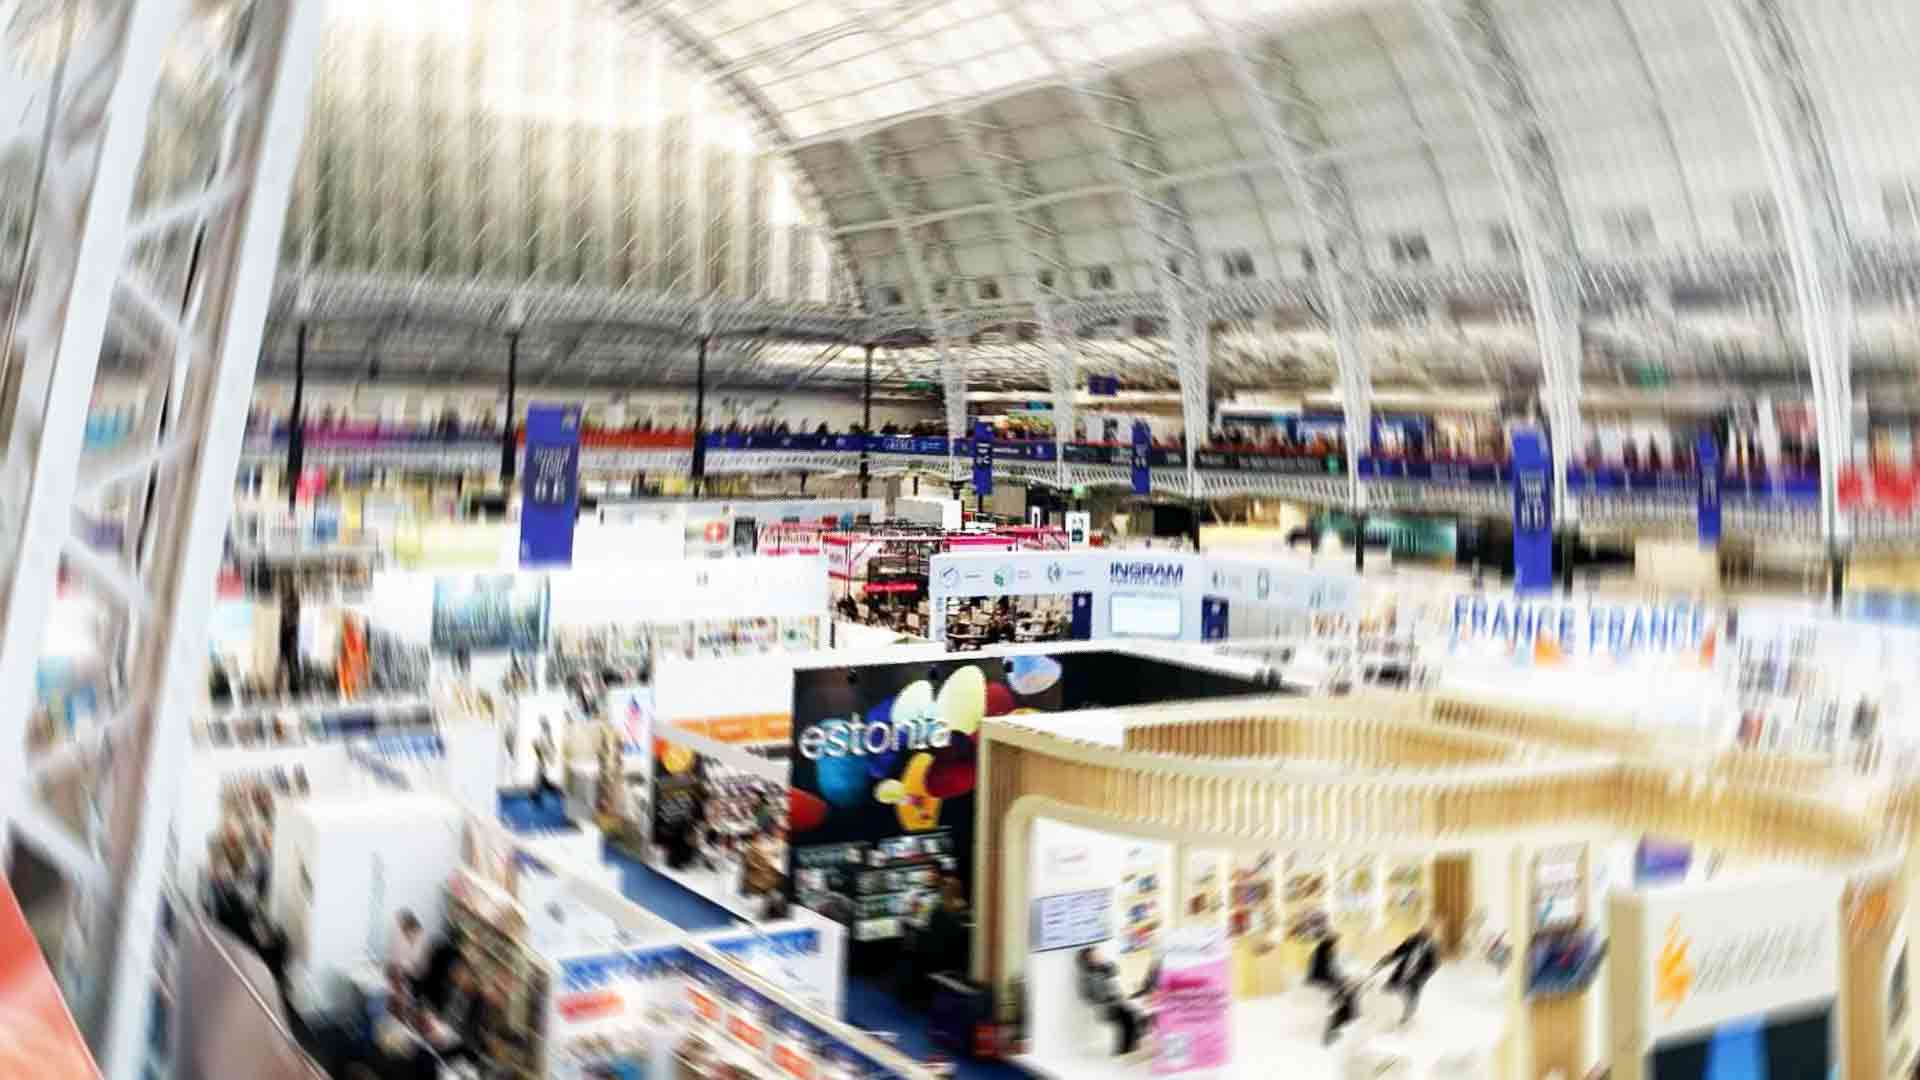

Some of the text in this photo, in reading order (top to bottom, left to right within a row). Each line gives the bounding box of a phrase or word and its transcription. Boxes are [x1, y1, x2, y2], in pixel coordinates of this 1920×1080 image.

[1110, 561, 1184, 579] INGRAM
[1452, 597, 1576, 648] FRANCE
[1588, 603, 1709, 651] FRANCE
[799, 711, 951, 759] estonia
